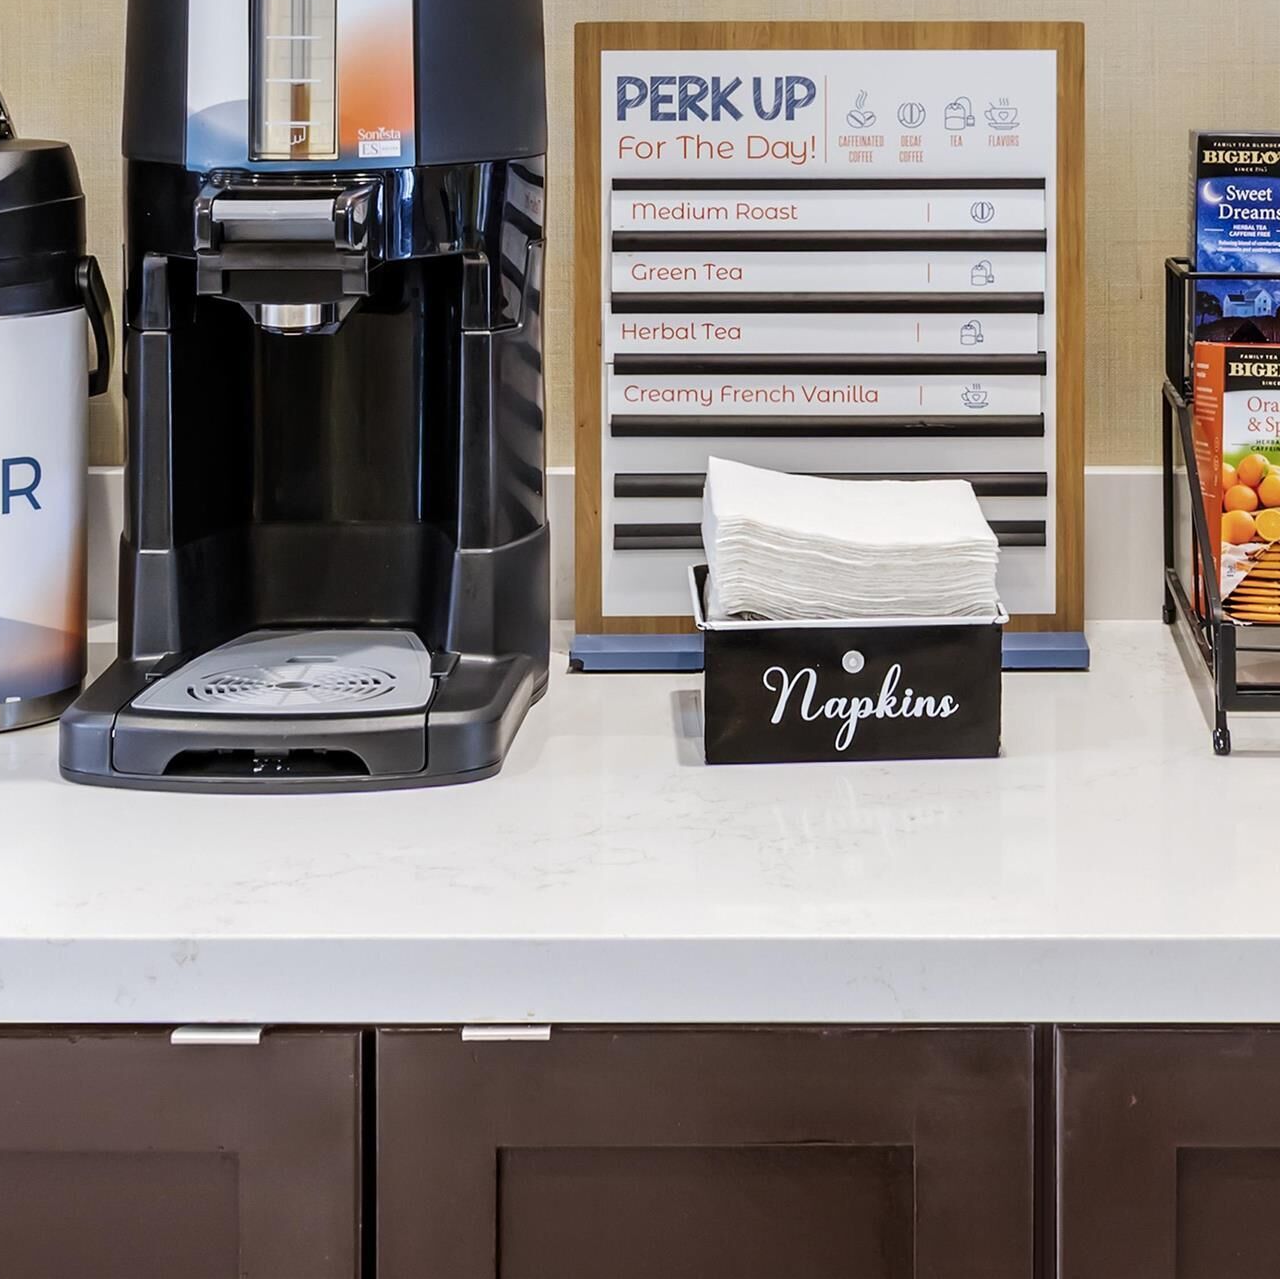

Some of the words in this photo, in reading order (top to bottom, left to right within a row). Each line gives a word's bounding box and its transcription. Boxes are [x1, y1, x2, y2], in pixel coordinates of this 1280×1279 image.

[616, 75, 744, 121] PERK
[753, 75, 817, 121] UP
[358, 126, 401, 140] Sonesta
[838, 135, 885, 147] CAFFEINATED
[900, 135, 923, 147] DECAF
[950, 135, 963, 147] TEA
[988, 135, 1020, 147] FLAVORS
[618, 135, 667, 159] For
[676, 134, 734, 159] The
[747, 135, 816, 165] Day!
[849, 151, 873, 163] COFFEE
[899, 151, 924, 163] COFFEE
[1226, 185, 1273, 201] Sweet
[632, 202, 728, 220] Medium
[736, 203, 798, 220] Roast
[631, 263, 697, 280] Green
[703, 263, 743, 280] Tea
[621, 322, 697, 340] Herbal
[702, 322, 741, 340] Tea
[623, 384, 713, 407] Creamy
[720, 384, 795, 402] French
[801, 384, 878, 402] Vanilla
[1247, 417, 1261, 432] &
[763, 663, 959, 751] Napkins
